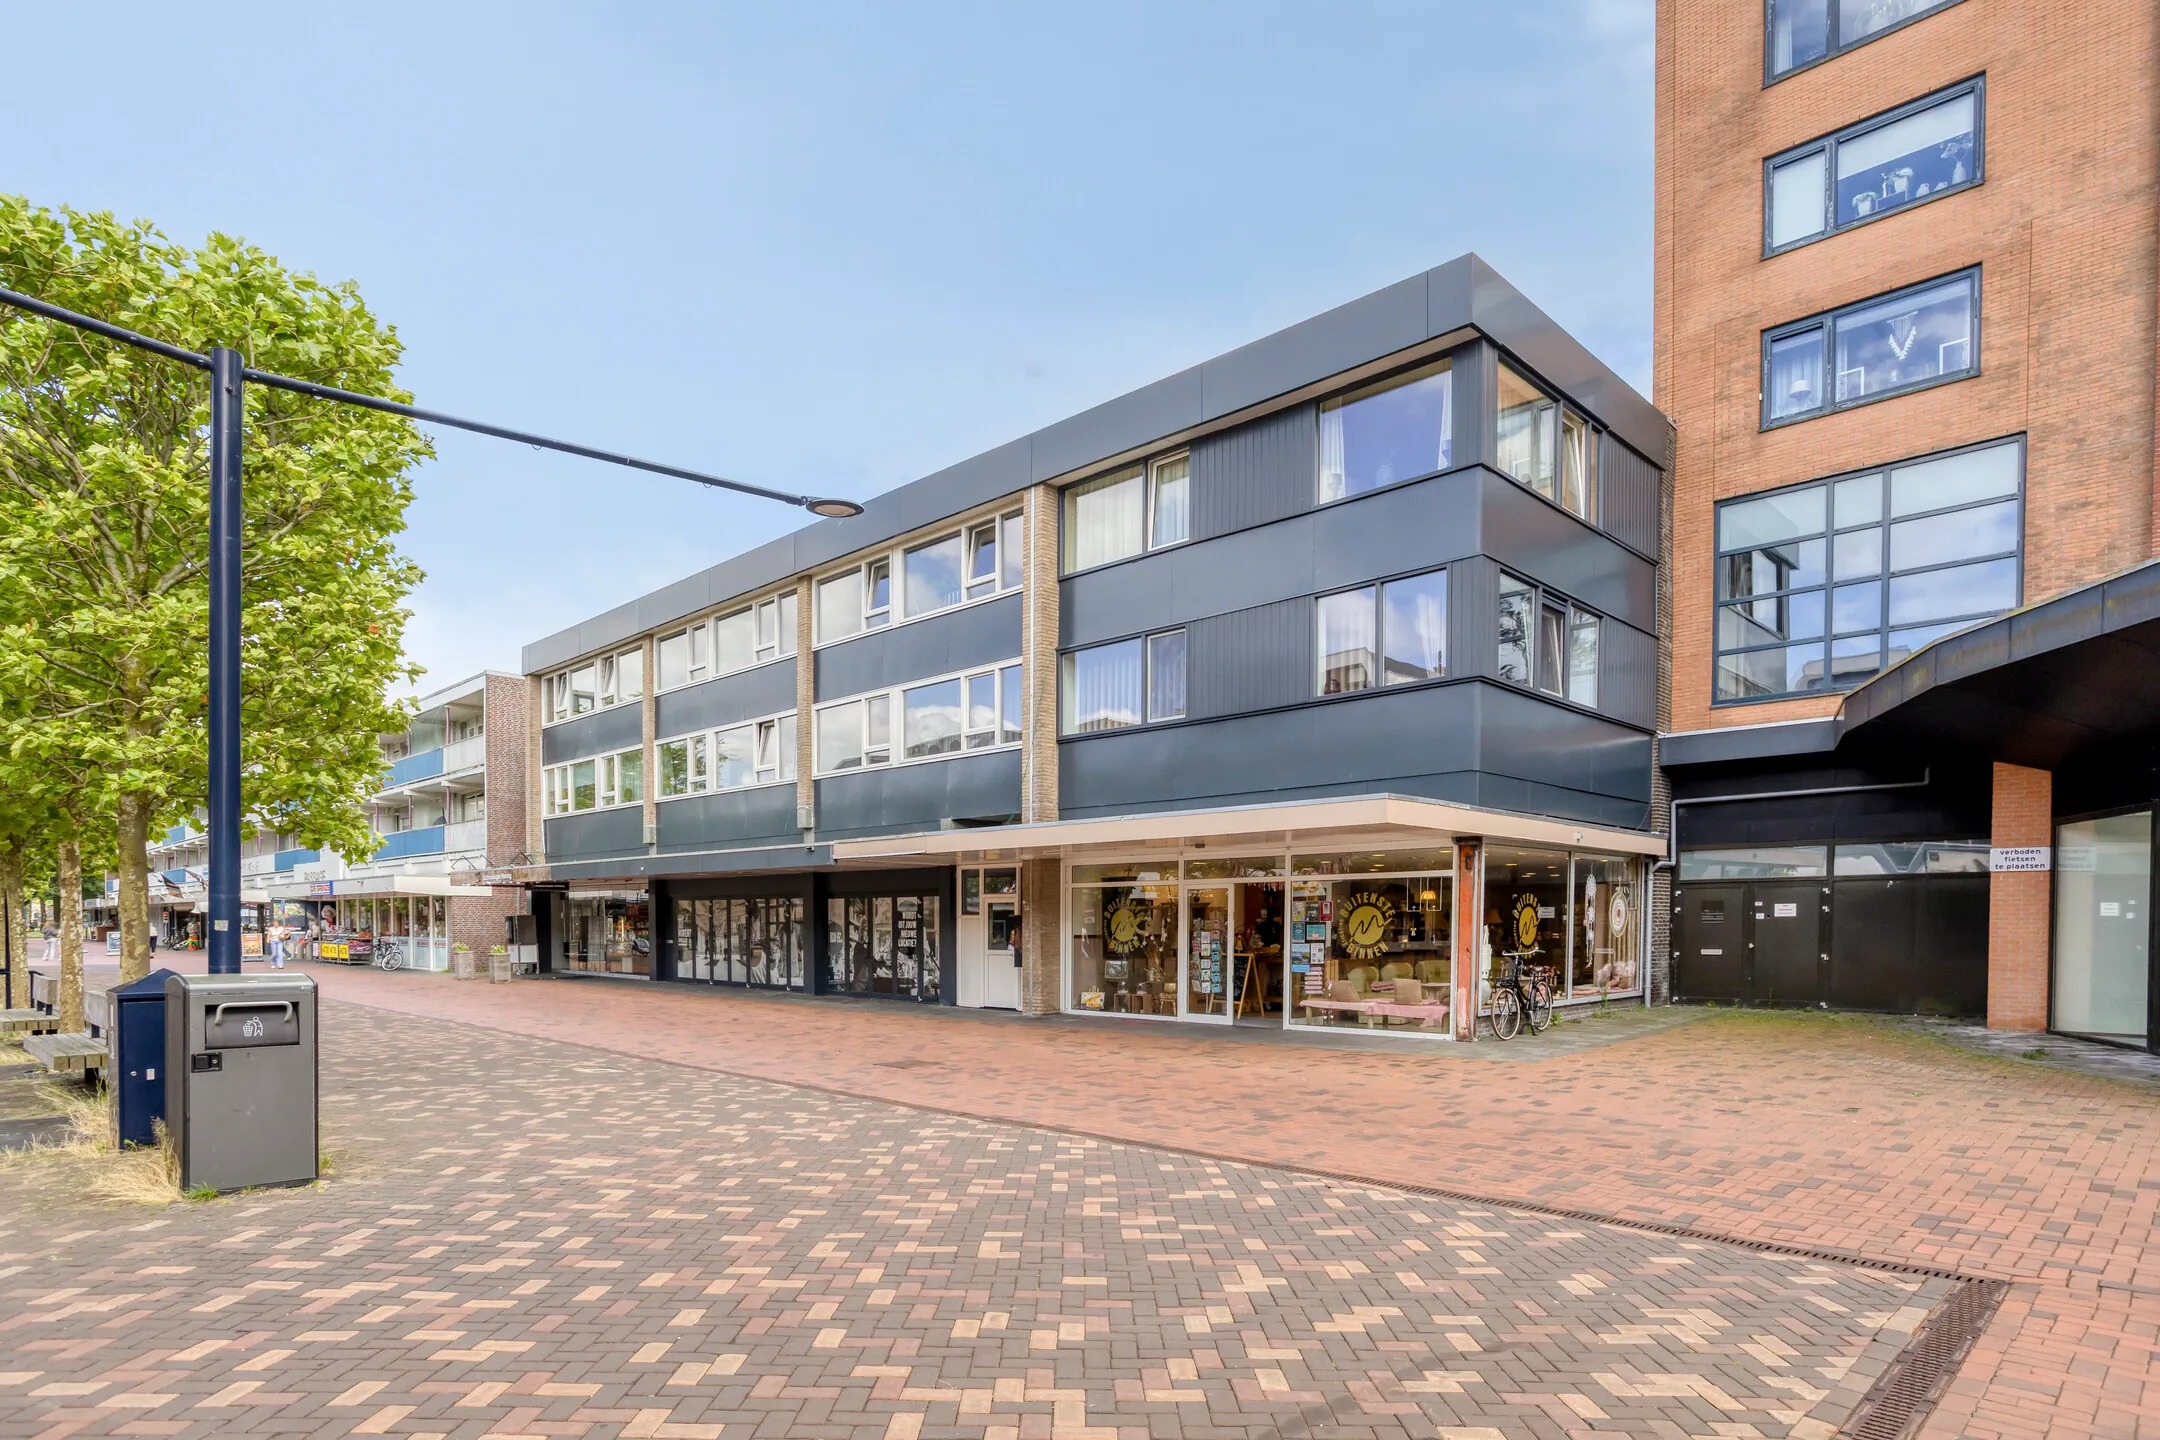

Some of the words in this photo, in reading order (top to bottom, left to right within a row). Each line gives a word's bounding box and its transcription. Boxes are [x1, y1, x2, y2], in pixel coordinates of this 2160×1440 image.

[2004, 855, 2036, 863] fietsen
[2006, 863, 2046, 871] plaatsen
[1340, 892, 1396, 918] BUITENSTE
[1346, 941, 1389, 959] BINNEN
